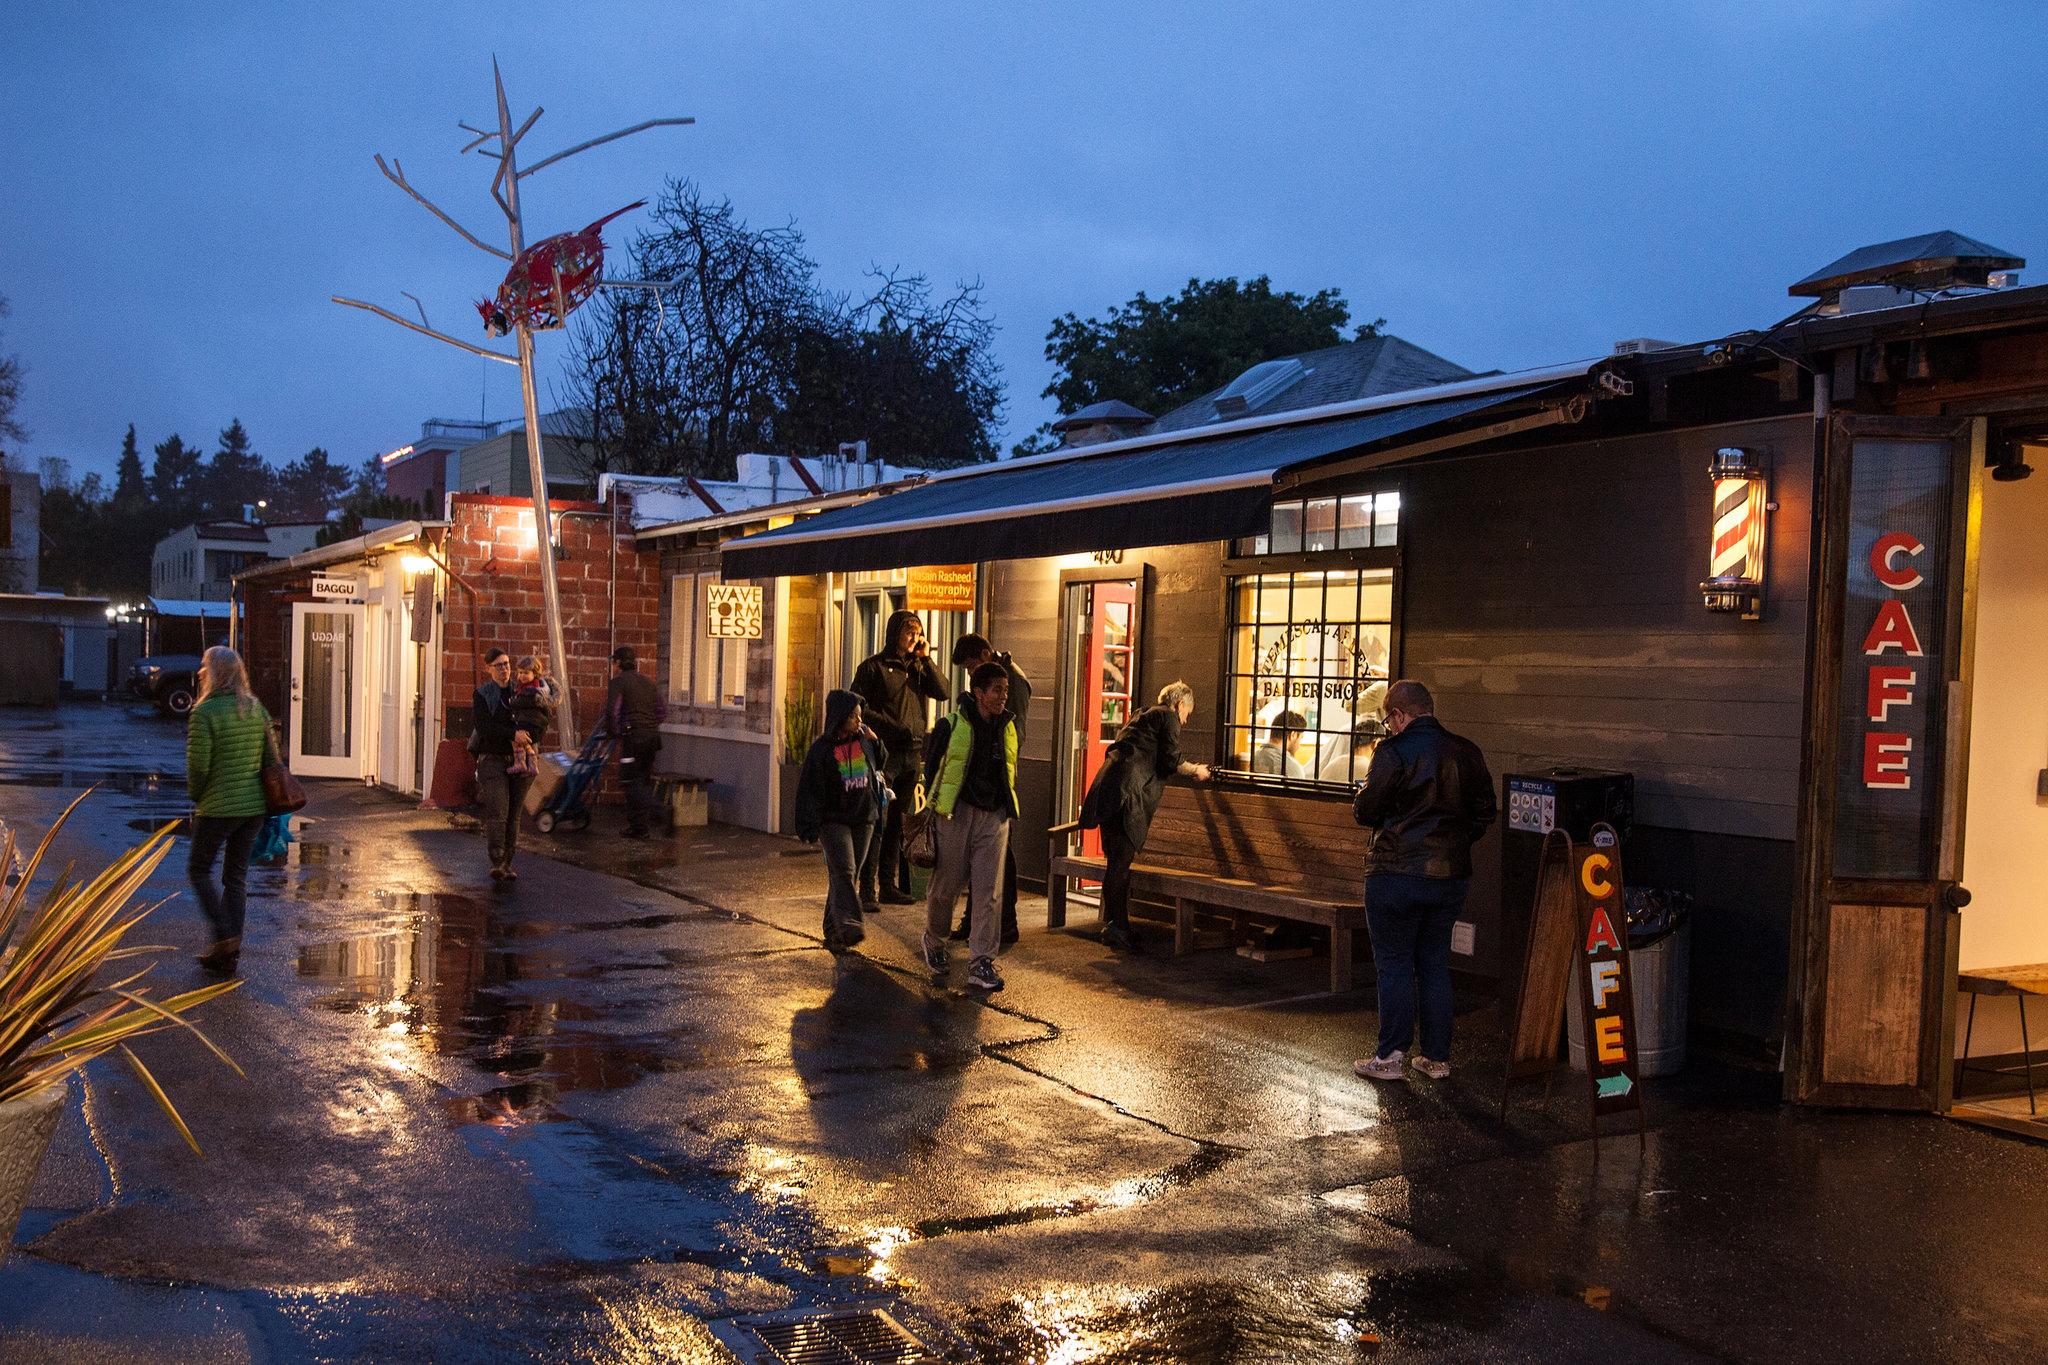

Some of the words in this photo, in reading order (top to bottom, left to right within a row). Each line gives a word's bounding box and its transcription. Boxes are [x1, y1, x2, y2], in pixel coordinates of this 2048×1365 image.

[938, 570, 972, 583] Rasheed
[316, 583, 355, 595] BAGGU
[709, 587, 761, 603] WAVE
[909, 583, 971, 598] Photography
[708, 601, 761, 618] FORM
[708, 617, 761, 637] LESS
[1862, 531, 1925, 789] CAFE
[1323, 682, 1364, 701] SHO
[1582, 853, 1627, 1065] CAFE
